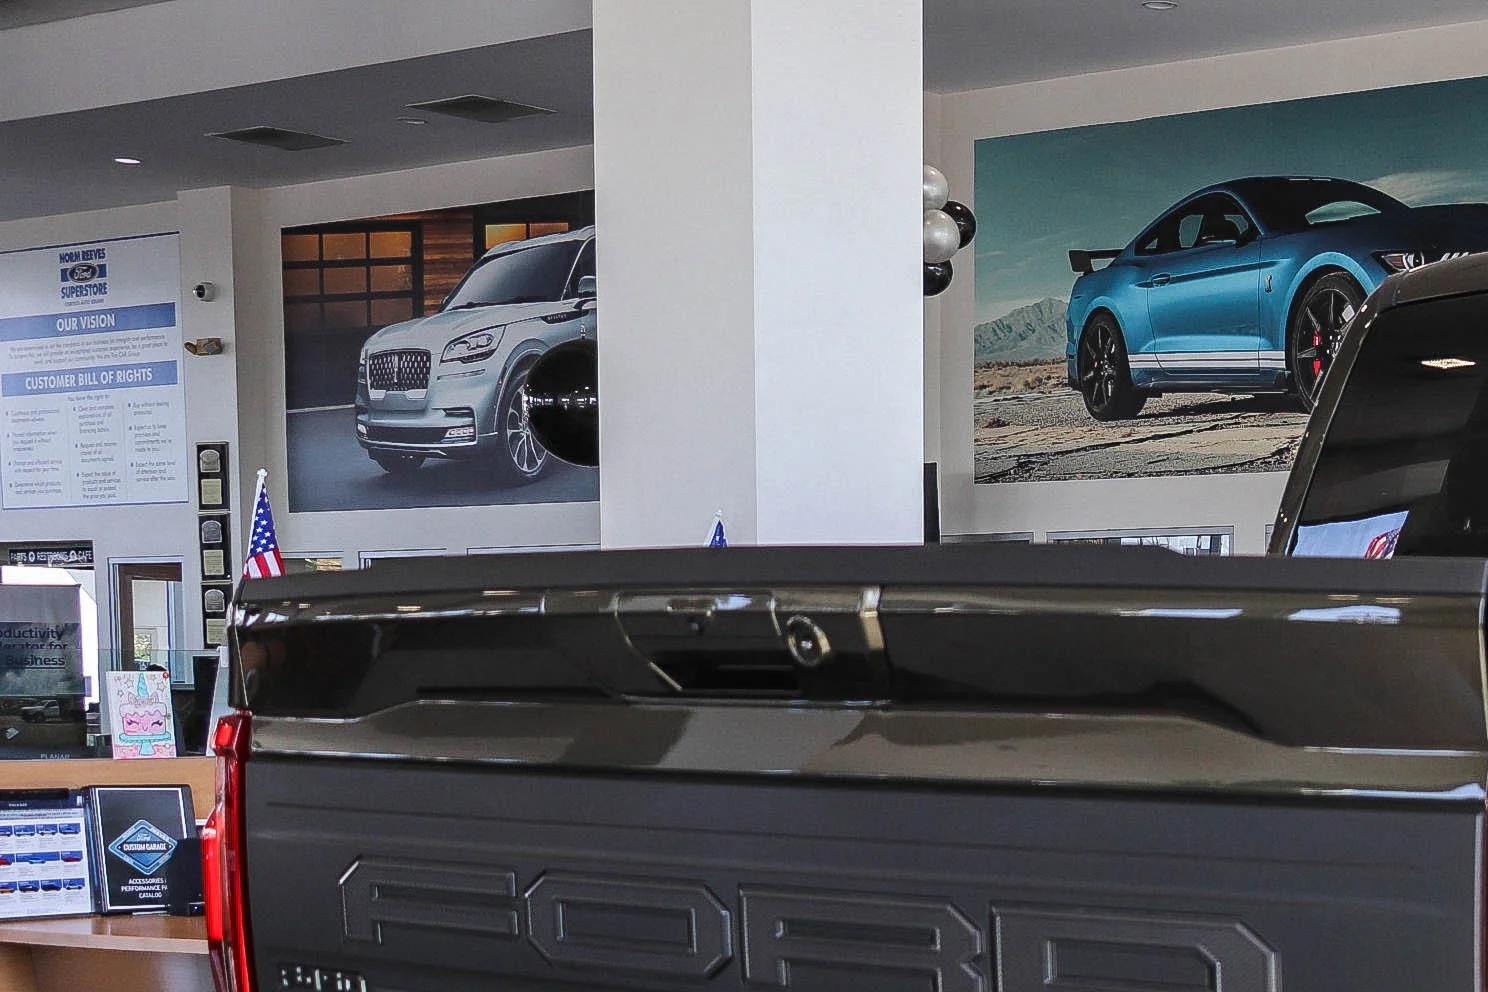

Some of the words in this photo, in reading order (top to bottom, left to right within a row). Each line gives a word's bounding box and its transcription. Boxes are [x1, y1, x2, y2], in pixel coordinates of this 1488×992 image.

[59, 250, 81, 264] NORM
[81, 248, 106, 262] REEVES
[61, 282, 108, 299] SUPERSTORE
[56, 317, 78, 332] OUR
[80, 313, 116, 330] VISION
[25, 373, 75, 390] CUSTOMER
[78, 372, 98, 386] BILL
[100, 371, 114, 385] OF
[116, 368, 153, 384] RIGHTS
[6, 655, 65, 667] Business
[123, 843, 146, 851] CUSTOM
[146, 843, 167, 851] GARAGE
[121, 885, 161, 893] PERFORMANCE
